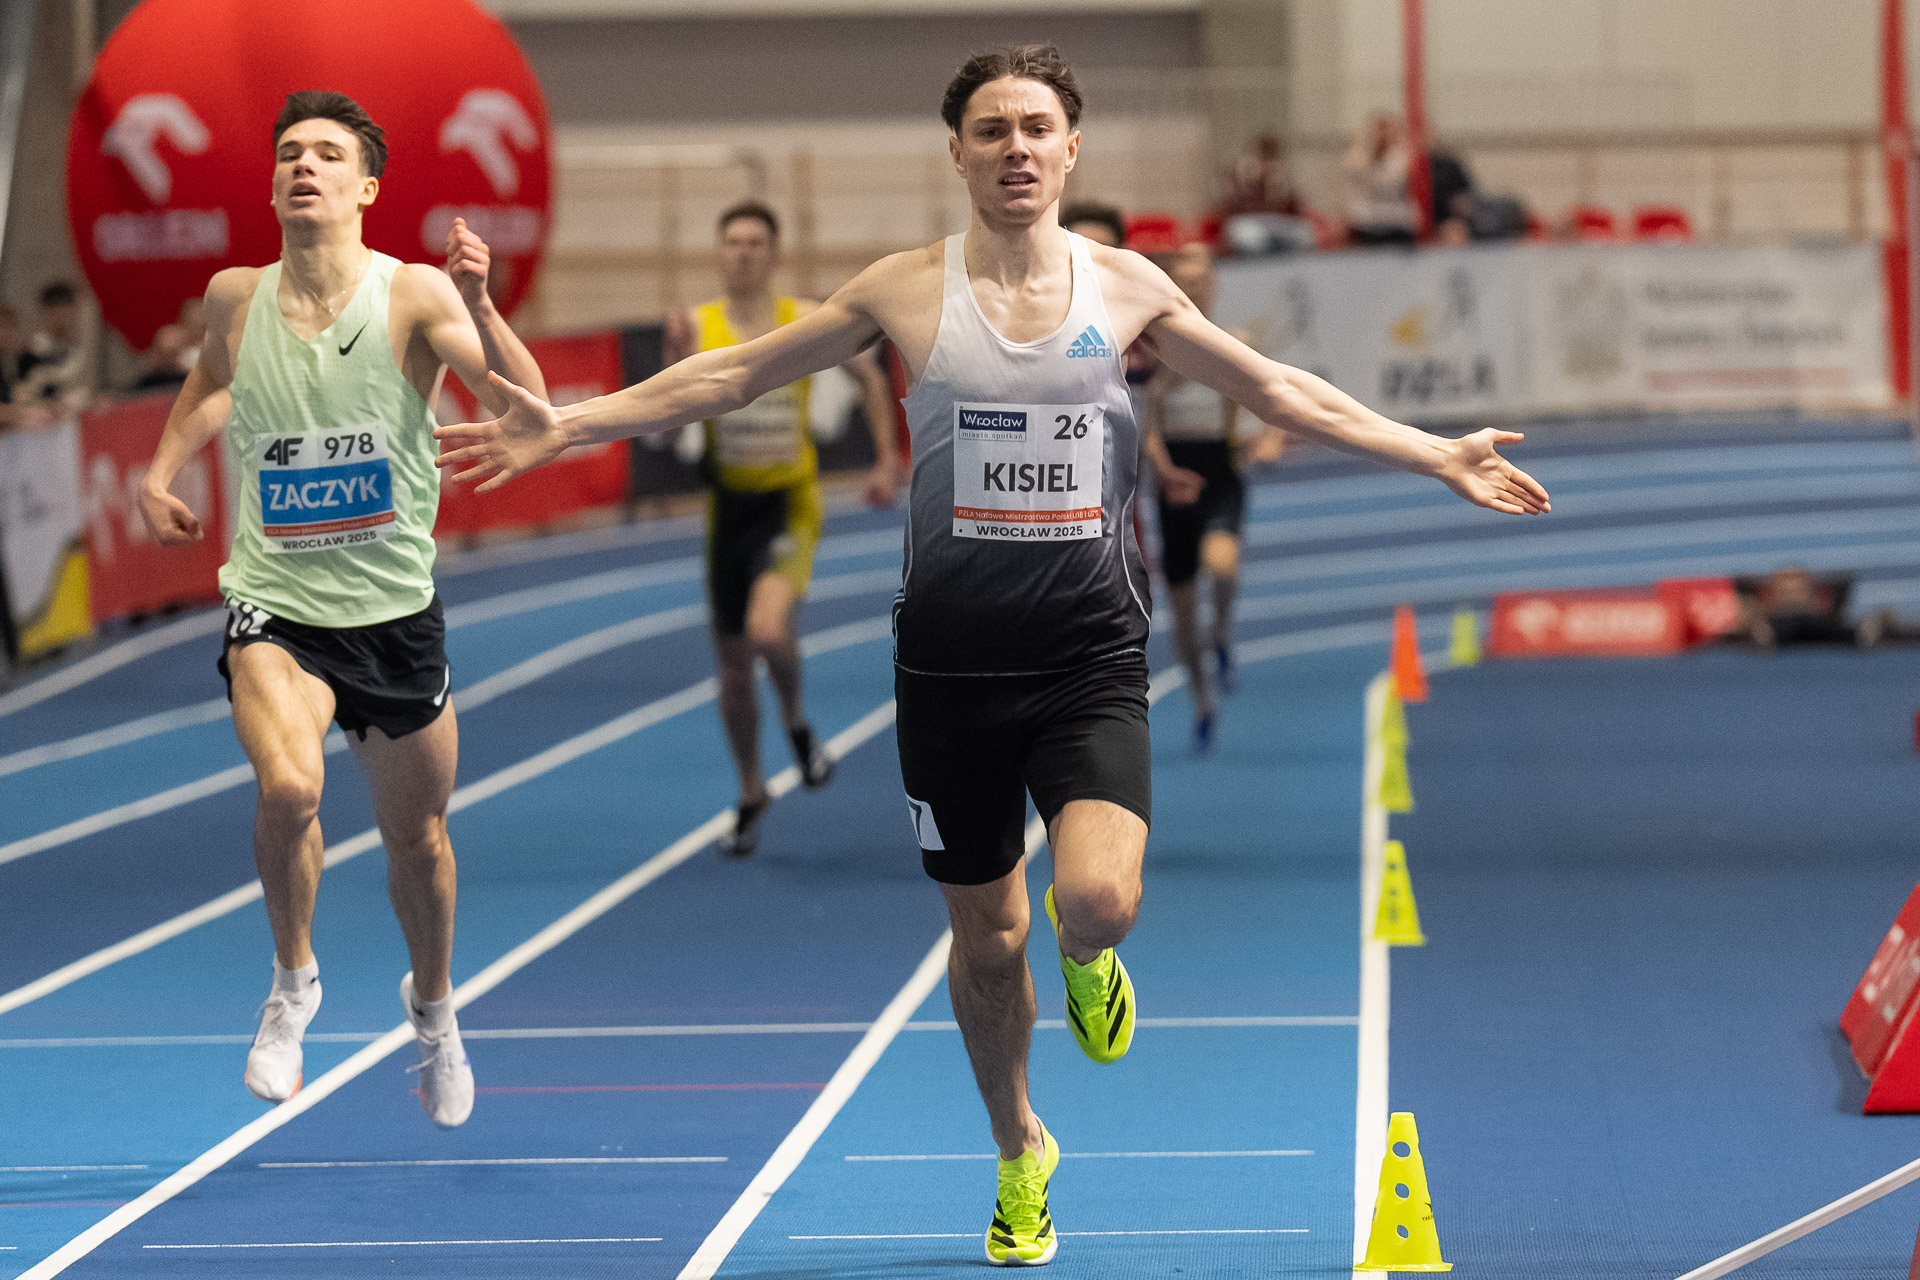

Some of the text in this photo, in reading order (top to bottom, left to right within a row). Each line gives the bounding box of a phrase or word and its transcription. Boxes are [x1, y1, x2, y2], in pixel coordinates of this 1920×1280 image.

[1066, 345, 1112, 358] adidas
[961, 412, 1024, 429] Wrocław
[1053, 413, 1088, 440] 26
[324, 432, 375, 460] 978
[961, 431, 1023, 441] miasto spotkań
[263, 437, 303, 466] 4F
[983, 462, 1079, 493] KISIEL
[268, 473, 381, 511] ZACZYK
[958, 509, 975, 518] PZLA
[281, 530, 377, 549] WROCŁAW 2025
[976, 525, 1084, 538] WROCŁAW 2025
[907, 799, 923, 845] 7
